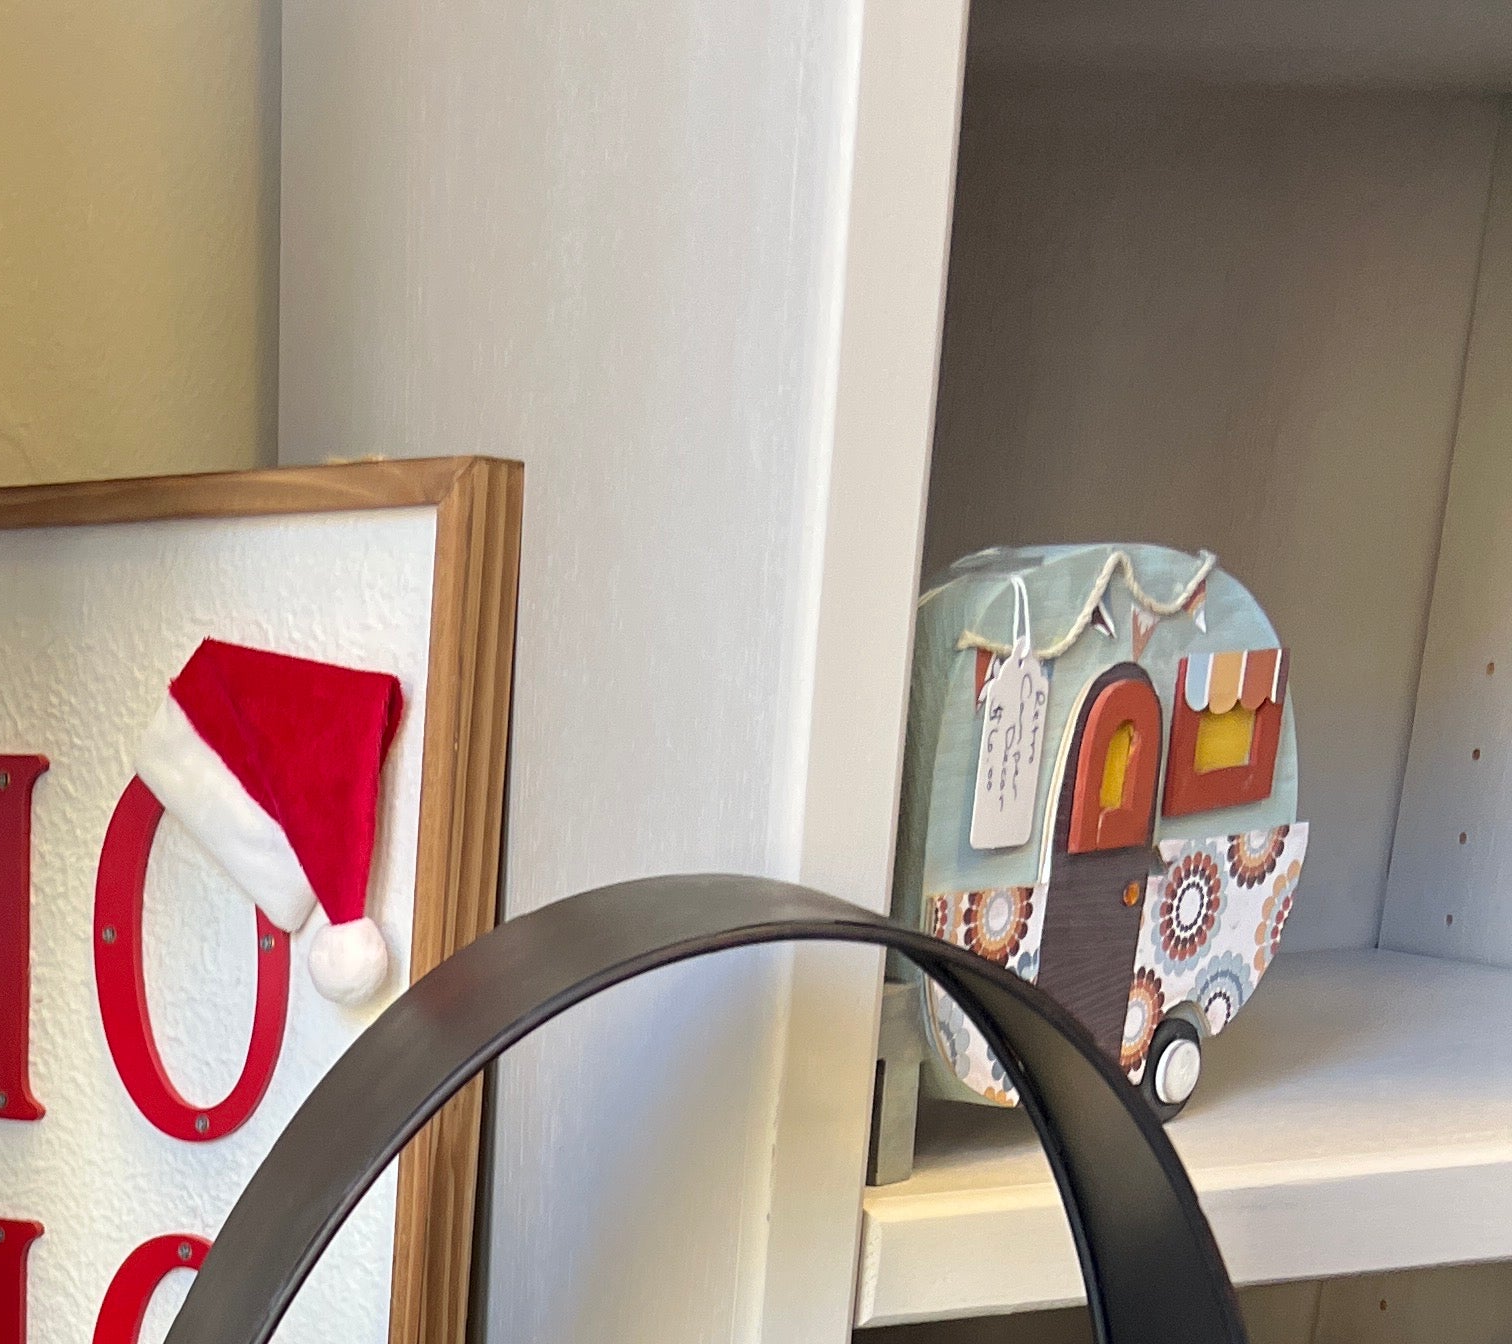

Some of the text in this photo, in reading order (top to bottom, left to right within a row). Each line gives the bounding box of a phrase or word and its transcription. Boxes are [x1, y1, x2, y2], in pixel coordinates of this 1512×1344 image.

[986, 698, 1003, 791] $6.00
[998, 724, 1016, 812] Decor
[1028, 690, 1046, 764] Retro
